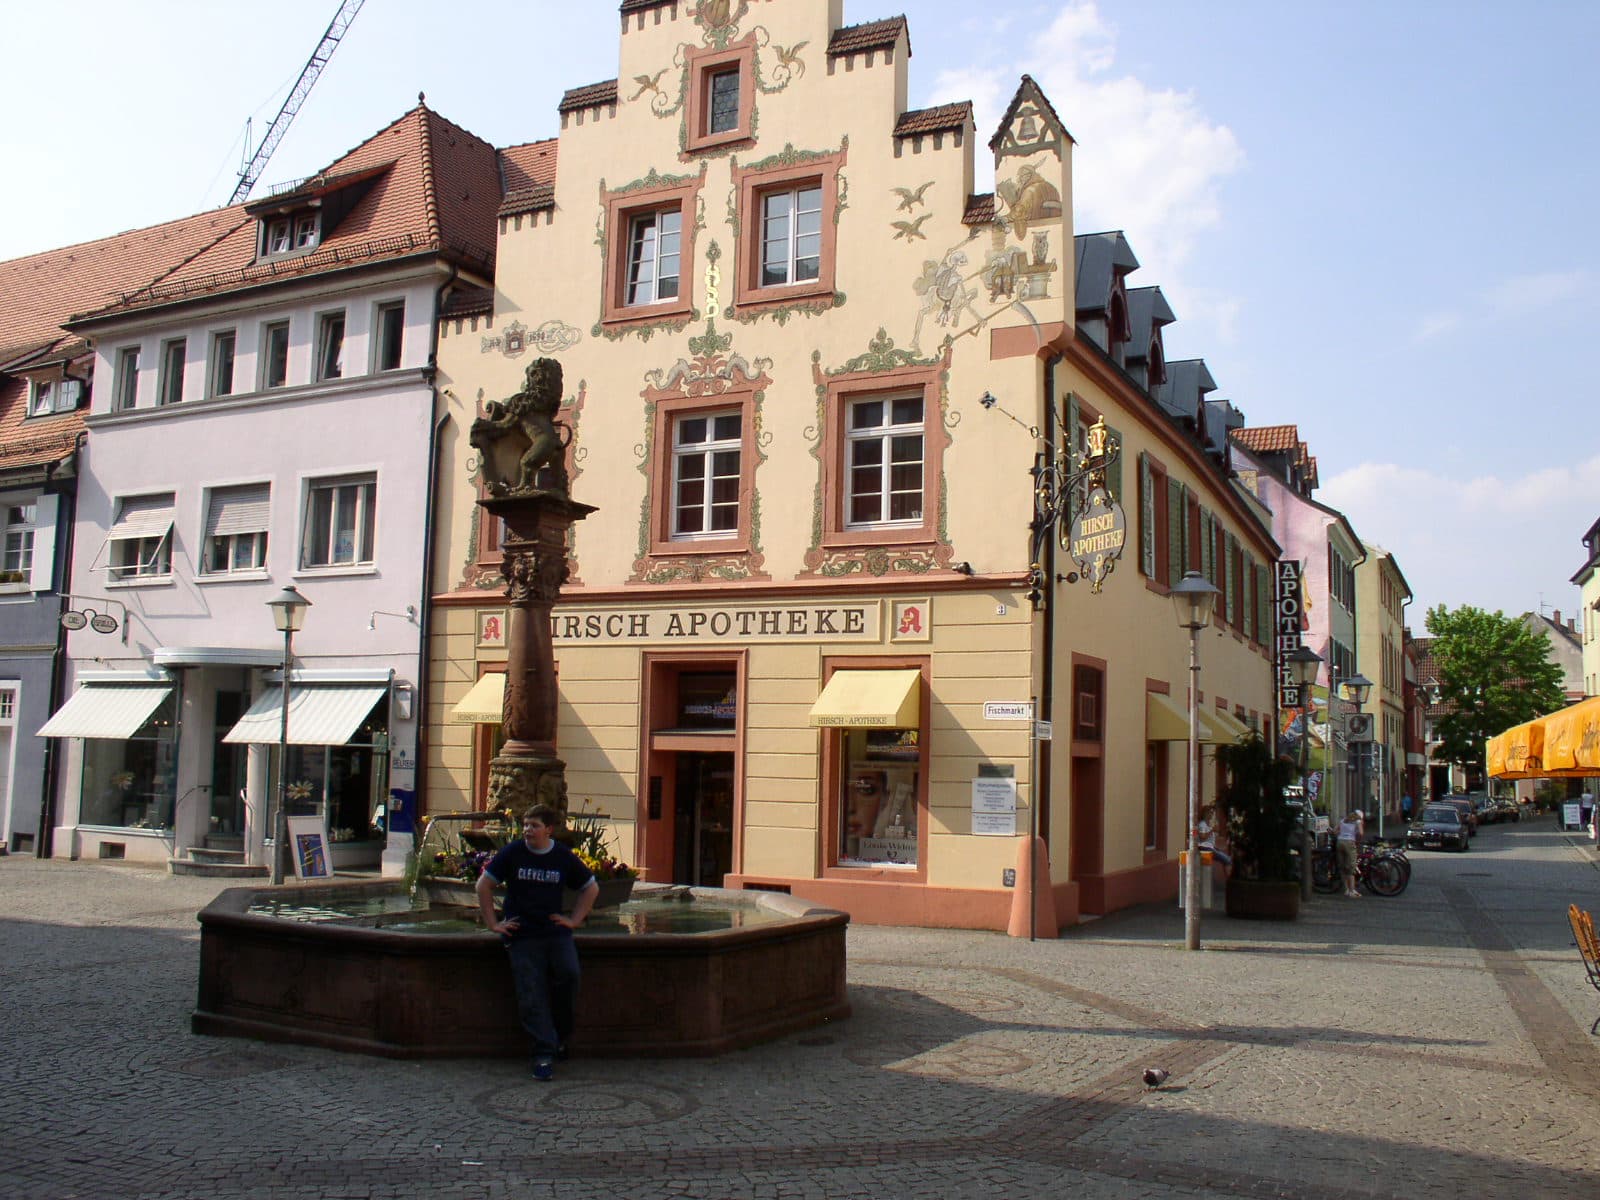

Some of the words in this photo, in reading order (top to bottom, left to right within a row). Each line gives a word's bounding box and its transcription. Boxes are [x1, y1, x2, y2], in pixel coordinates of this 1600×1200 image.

[1080, 513, 1115, 536] HIRSCH
[1072, 529, 1124, 557] APOTHEKE
[551, 614, 650, 638] IRSCH
[663, 608, 865, 637] APOTHEKE
[987, 705, 1025, 715] Fischmarkt
[818, 716, 844, 725] HIRSCH
[848, 716, 887, 725] APOTHEKE
[518, 867, 560, 883] CLEVELAND
